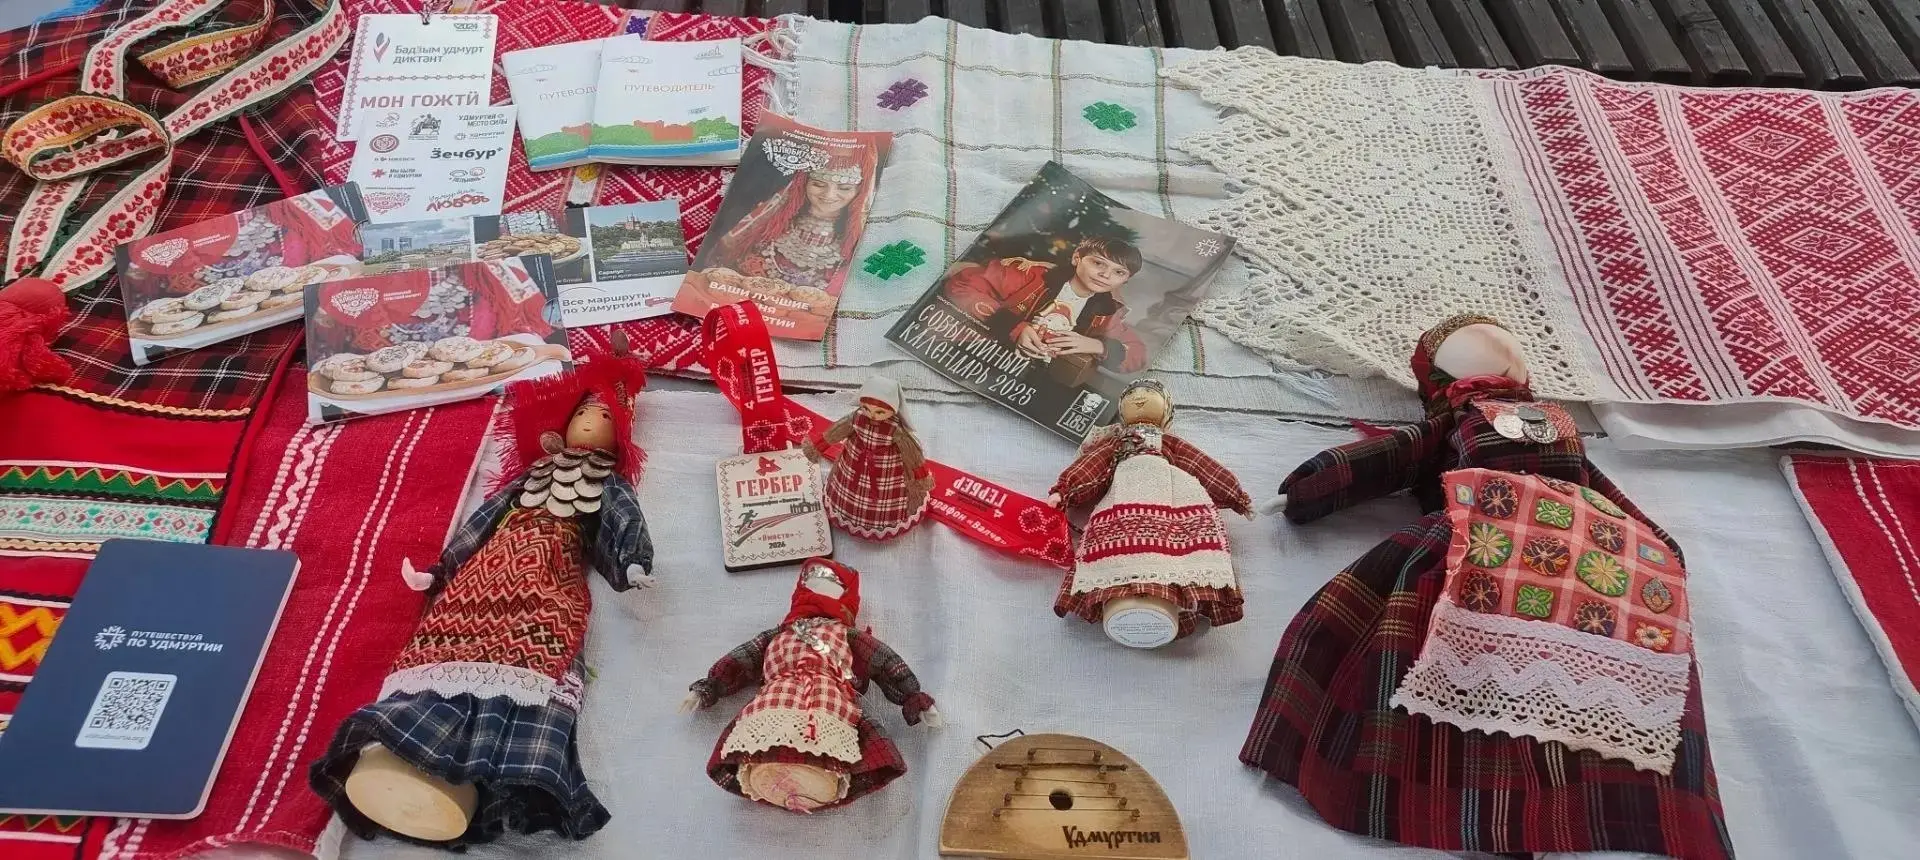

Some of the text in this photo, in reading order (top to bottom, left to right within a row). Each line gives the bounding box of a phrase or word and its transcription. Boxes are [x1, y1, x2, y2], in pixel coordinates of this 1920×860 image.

[442, 45, 484, 56] удмурт
[393, 55, 444, 64] диктант
[624, 83, 716, 93] ПУТЕВОДИТЕЛЬ
[360, 96, 404, 109] МОН
[562, 292, 651, 307] Все маршруты
[709, 281, 811, 310] ВАШИ ЛУЧШИЕ
[563, 301, 642, 315] по Удмуртии
[918, 303, 1032, 378] СОБЫТИЙНЫЙ
[750, 348, 775, 403] ГЕРБЕР
[989, 374, 1036, 406] 2025
[1062, 412, 1090, 432] 185
[736, 474, 803, 498] ГЕРБЕР
[953, 476, 1008, 508] ГЕРБЕР
[131, 630, 203, 641] ПУТЕШЕСТВУЙ
[126, 638, 224, 652] ПО УДМУРТИИ
[1061, 825, 1161, 848] Удмуртия
